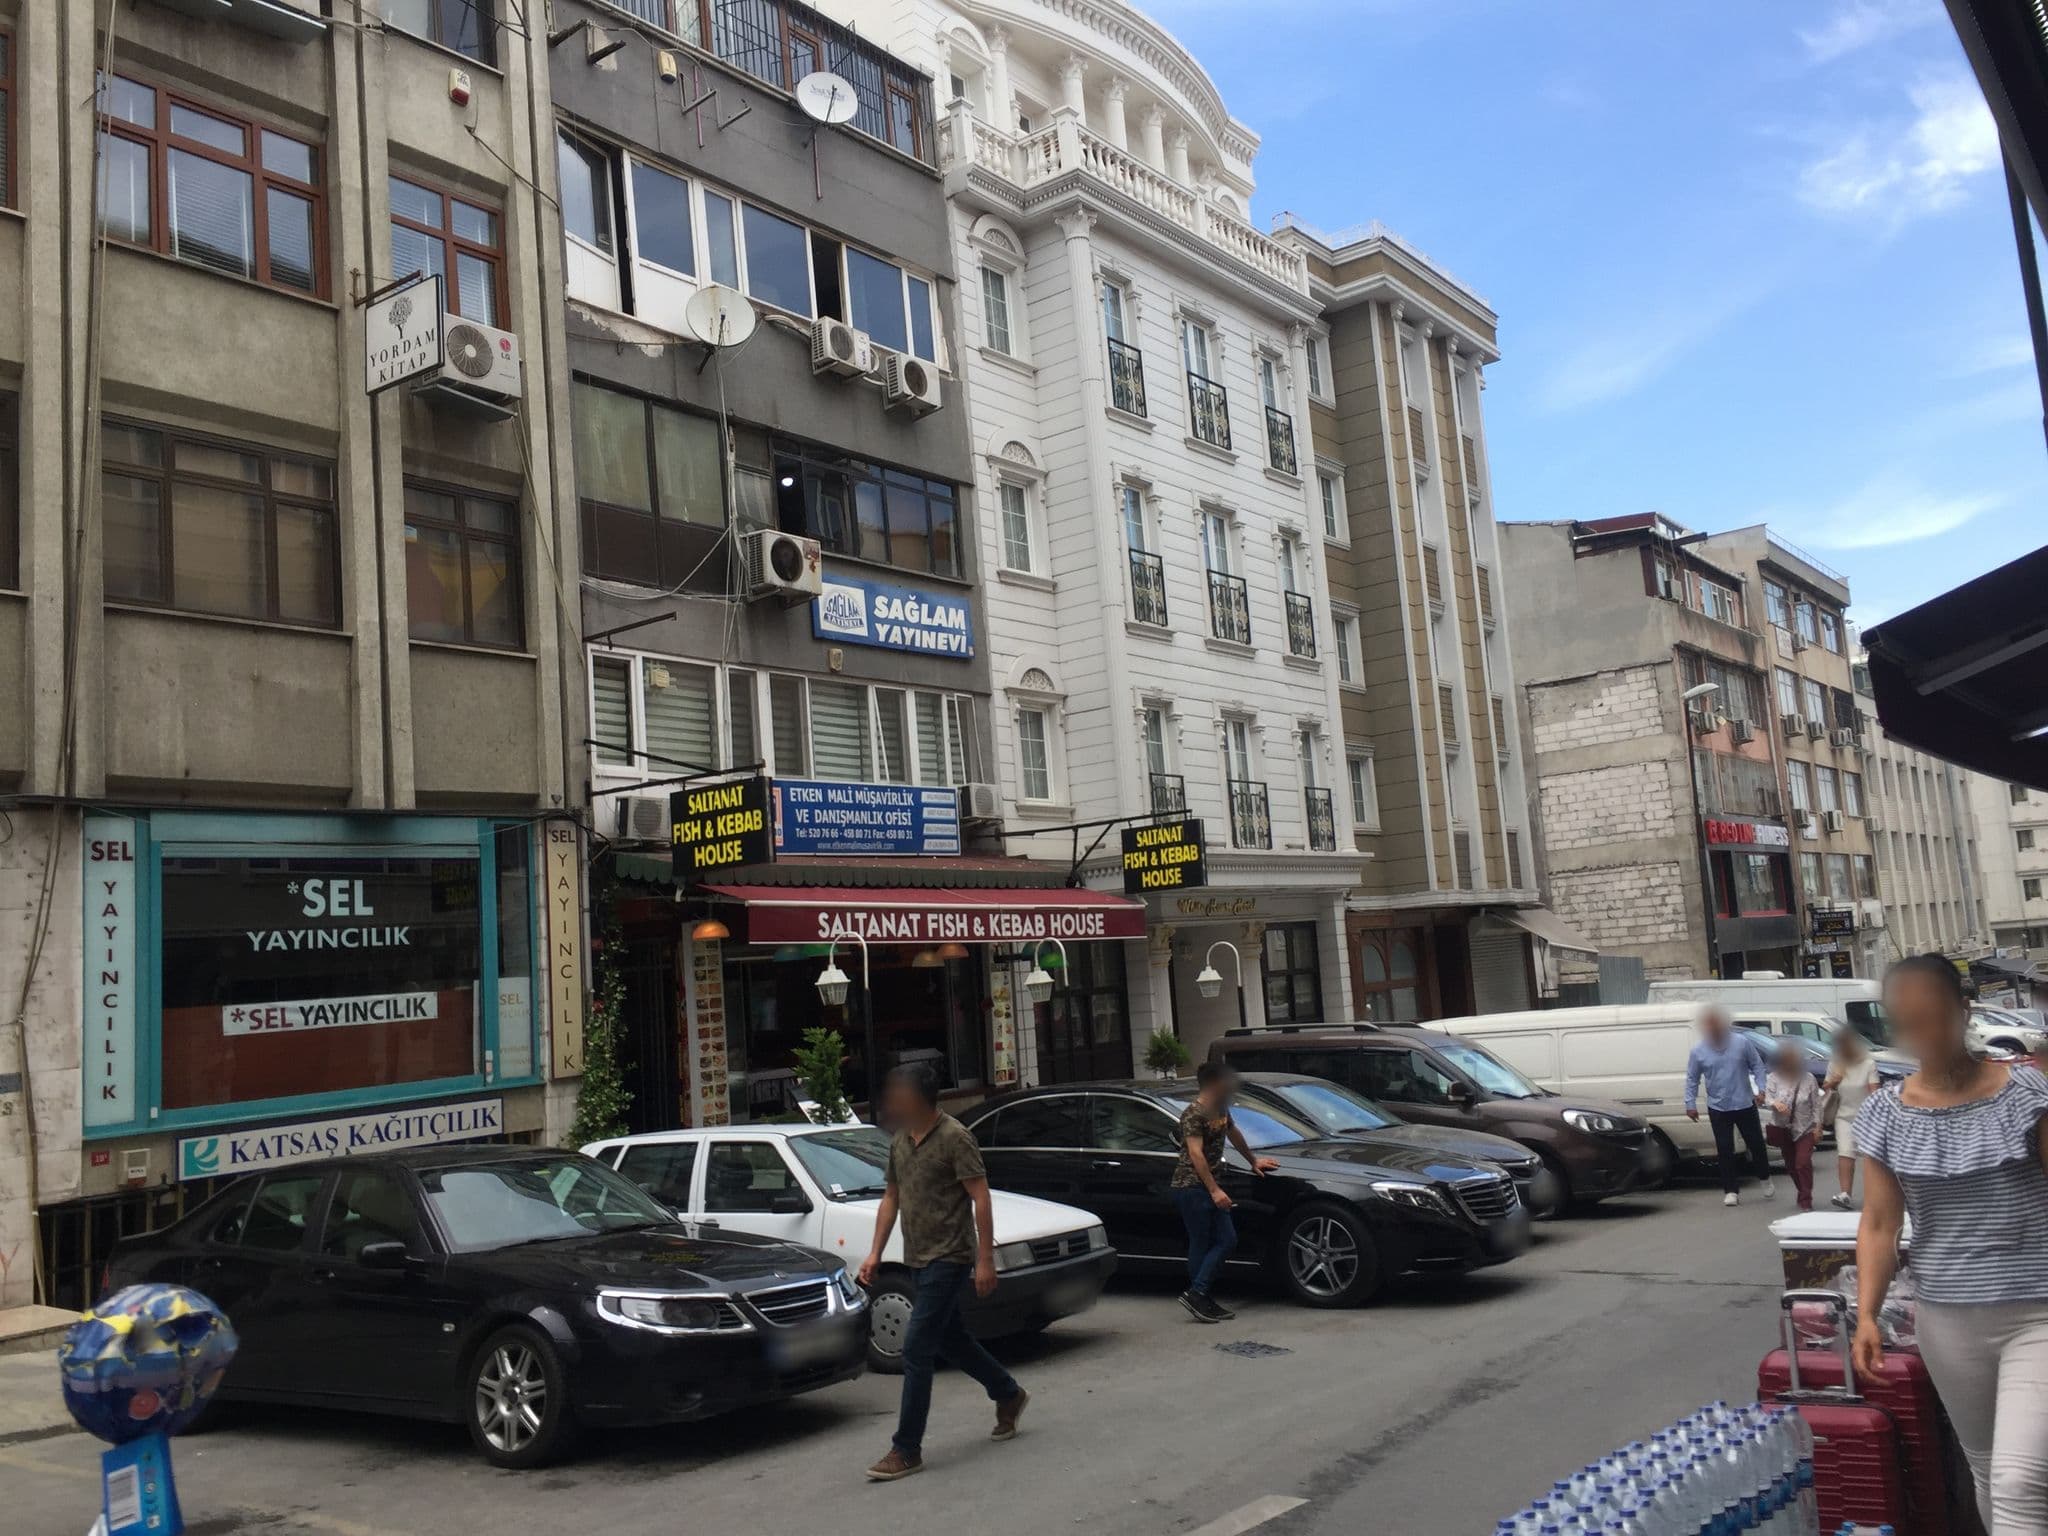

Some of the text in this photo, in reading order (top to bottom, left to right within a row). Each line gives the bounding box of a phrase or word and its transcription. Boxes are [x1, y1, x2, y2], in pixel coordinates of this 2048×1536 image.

[370, 328, 435, 367] YORDAM
[379, 352, 427, 383] KİTAP
[873, 594, 967, 631] SAĞLAM
[875, 623, 967, 653] YAYINEVİ
[688, 785, 744, 815] SALTANAT
[789, 788, 823, 803] ETKEN
[827, 786, 853, 804] MALİ
[855, 787, 914, 808] MÜŞAVİRLİK
[673, 809, 763, 845] FISH & KEBAB
[795, 809, 809, 824] VE
[814, 809, 884, 827] DANIŞMANLIK
[885, 808, 913, 826] OFİSİ
[90, 840, 134, 862] SEL
[551, 829, 576, 844] SEL
[1136, 825, 1184, 848] SALTANAT
[694, 840, 743, 868] HOUSE
[1124, 844, 1199, 870] FISH & KEBAB
[1141, 867, 1183, 888] HOUSE
[302, 878, 375, 918] SEL
[246, 926, 411, 952] YAYINCILIK
[818, 911, 1105, 938] SALTANAT FISH & KEBAB HOUSE
[557, 852, 576, 1070] YAYINCILIK
[102, 881, 120, 1100] YAYINCILIK
[499, 992, 524, 1006] SEL
[249, 997, 428, 1031] SEL YAYINCILIK
[230, 1105, 498, 1165] KATSAŞ KAĞITÇILIK
